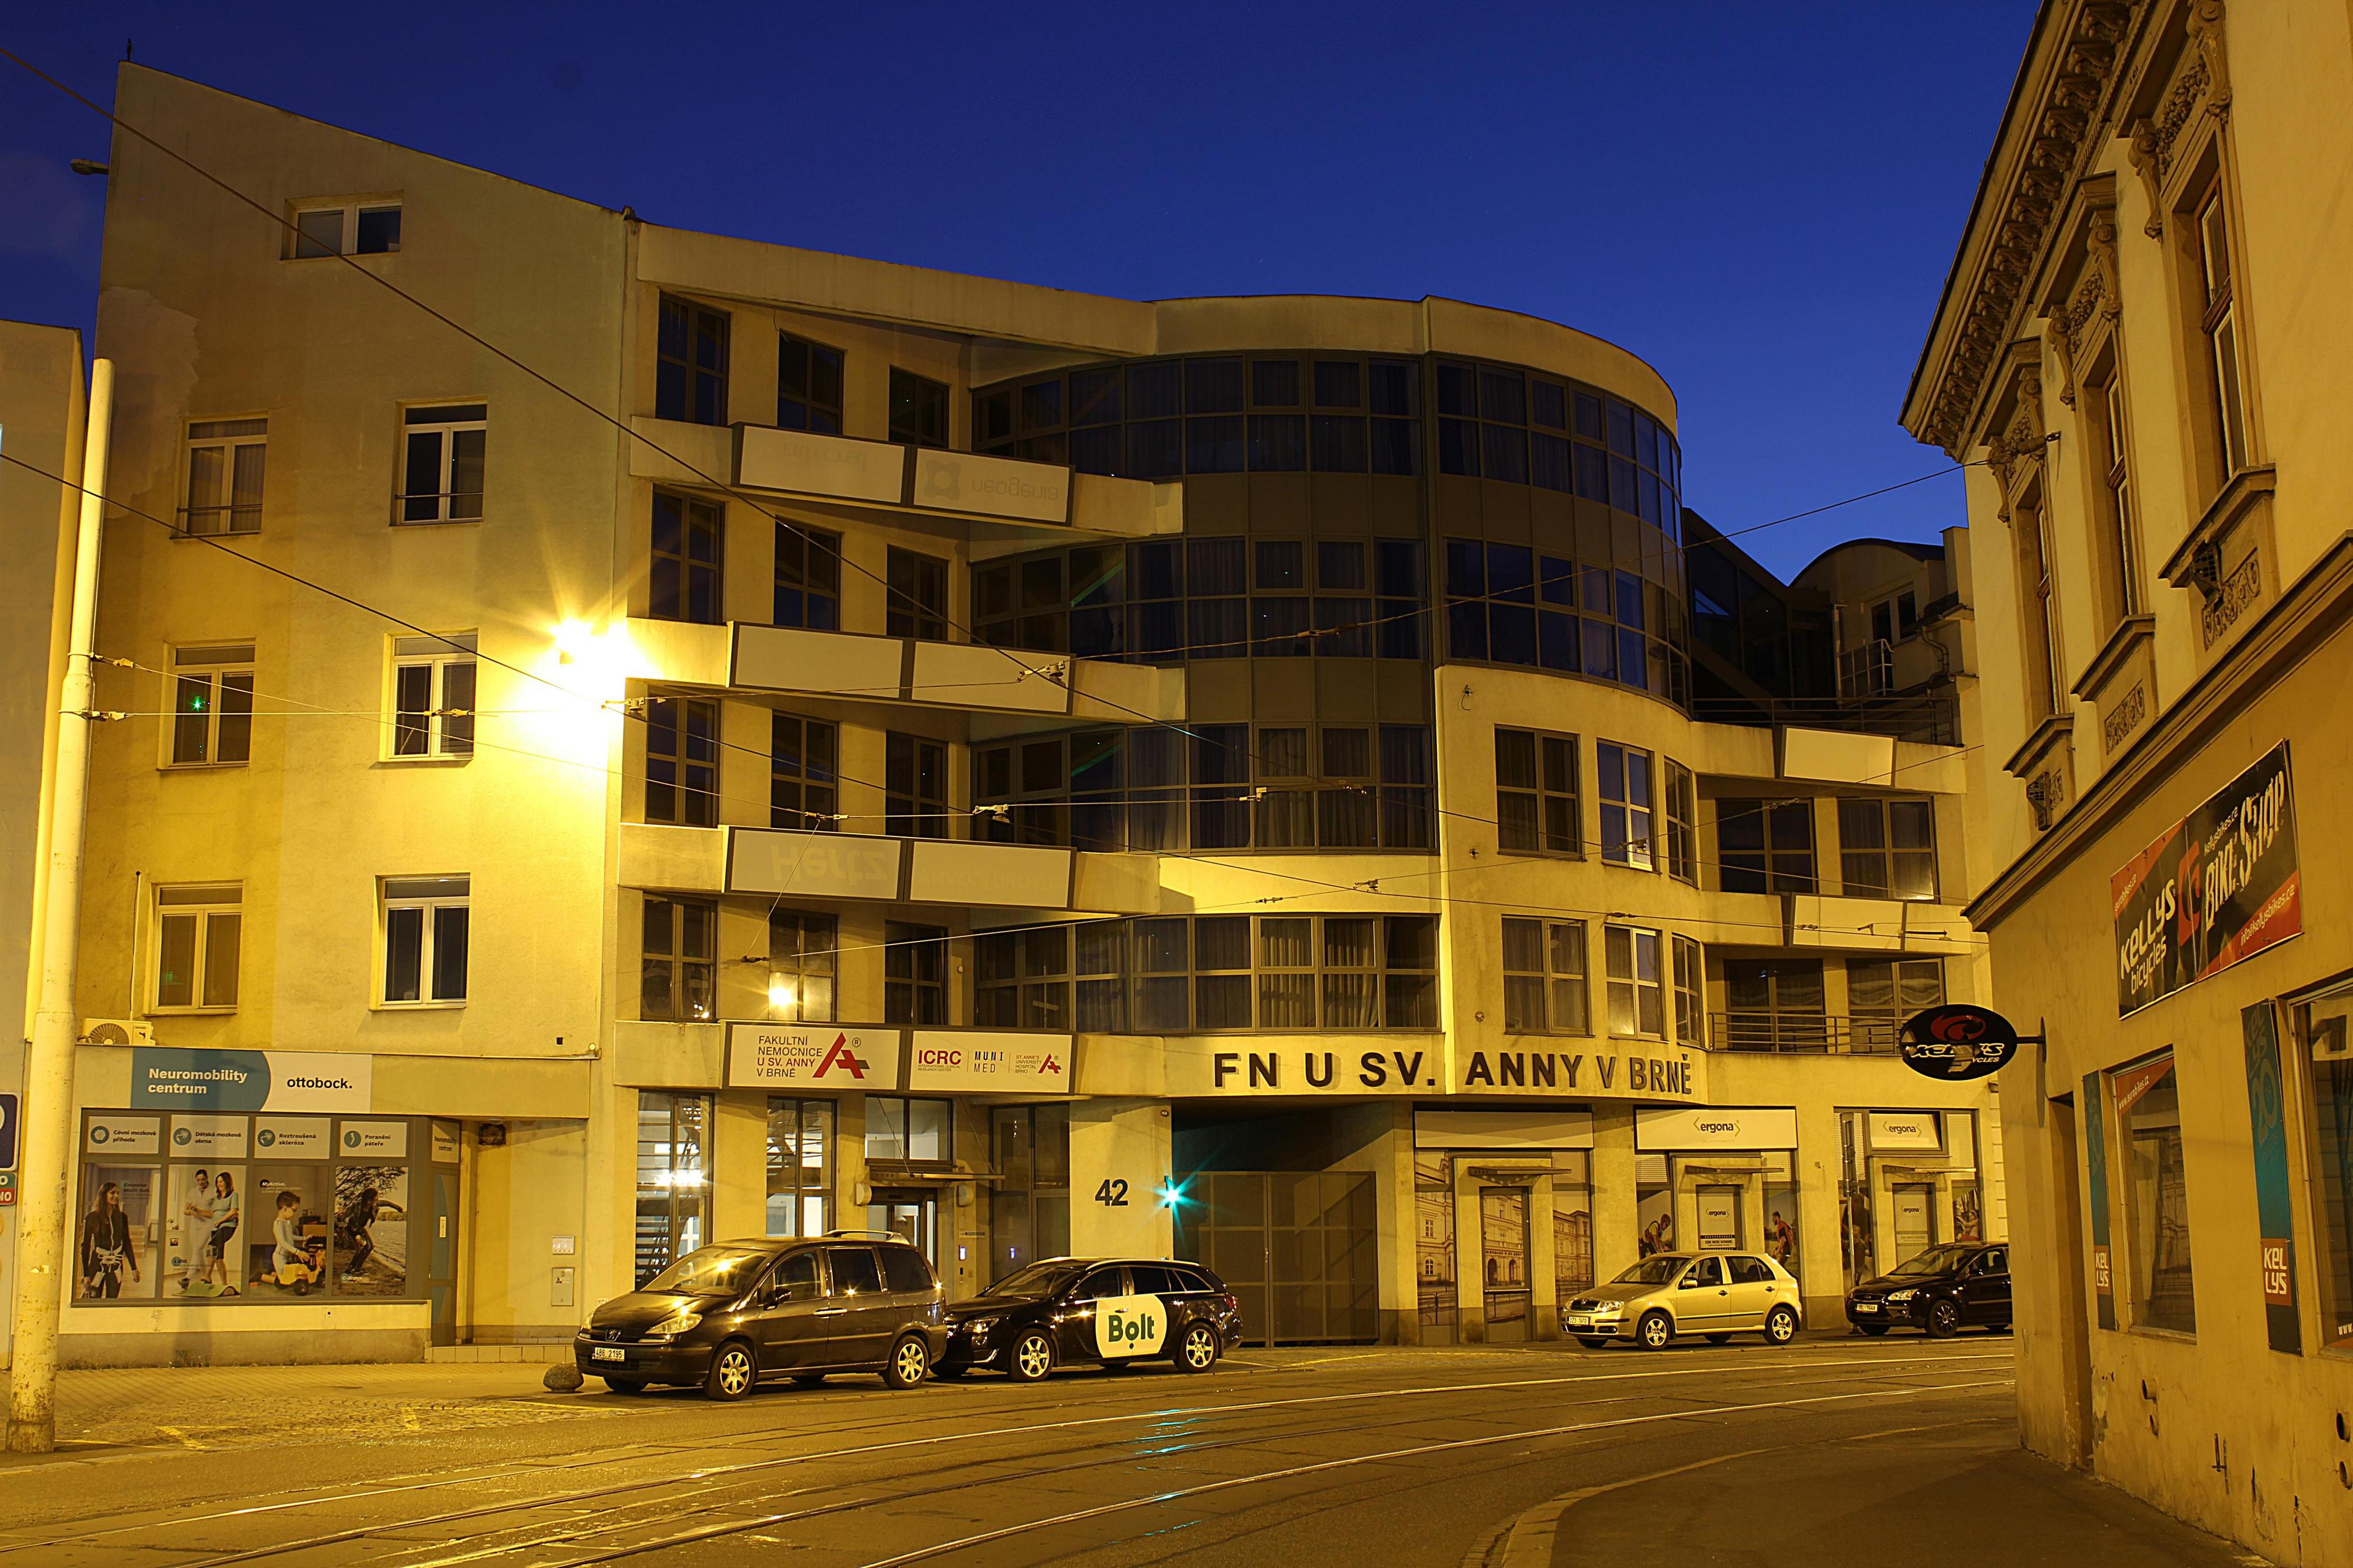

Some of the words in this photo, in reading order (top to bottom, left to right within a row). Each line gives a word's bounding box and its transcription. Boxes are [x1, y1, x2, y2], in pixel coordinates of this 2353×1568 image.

[2131, 935, 2167, 995] bicycles
[758, 1035, 808, 1046] FAKULTNÍ
[758, 1047, 823, 1057] NEMOCNICE
[918, 1050, 962, 1065] ICRC
[974, 1051, 1004, 1062] MUNI
[757, 1057, 764, 1066] U
[768, 1058, 782, 1067] SV.
[786, 1058, 816, 1067] ANNY
[756, 1068, 764, 1077] V
[766, 1067, 796, 1077] BRNĚ
[974, 1063, 996, 1073] MED
[1214, 1052, 1279, 1088] FN
[1304, 1052, 1334, 1087] U
[1359, 1051, 1435, 1087] SV.
[1465, 1052, 1584, 1088] ANNY
[1596, 1056, 1617, 1089] V
[1630, 1054, 1693, 1095] BRNĚ
[149, 1068, 248, 1084] Neuromobility
[148, 1083, 207, 1094] centrum
[286, 1077, 353, 1089] ottobock.
[1700, 1123, 1734, 1133] ergona
[1888, 1125, 1917, 1134] ergona
[1094, 1178, 1129, 1207] 42
[1108, 1313, 1155, 1343] Bolt
[608, 1350, 622, 1359] 2195
